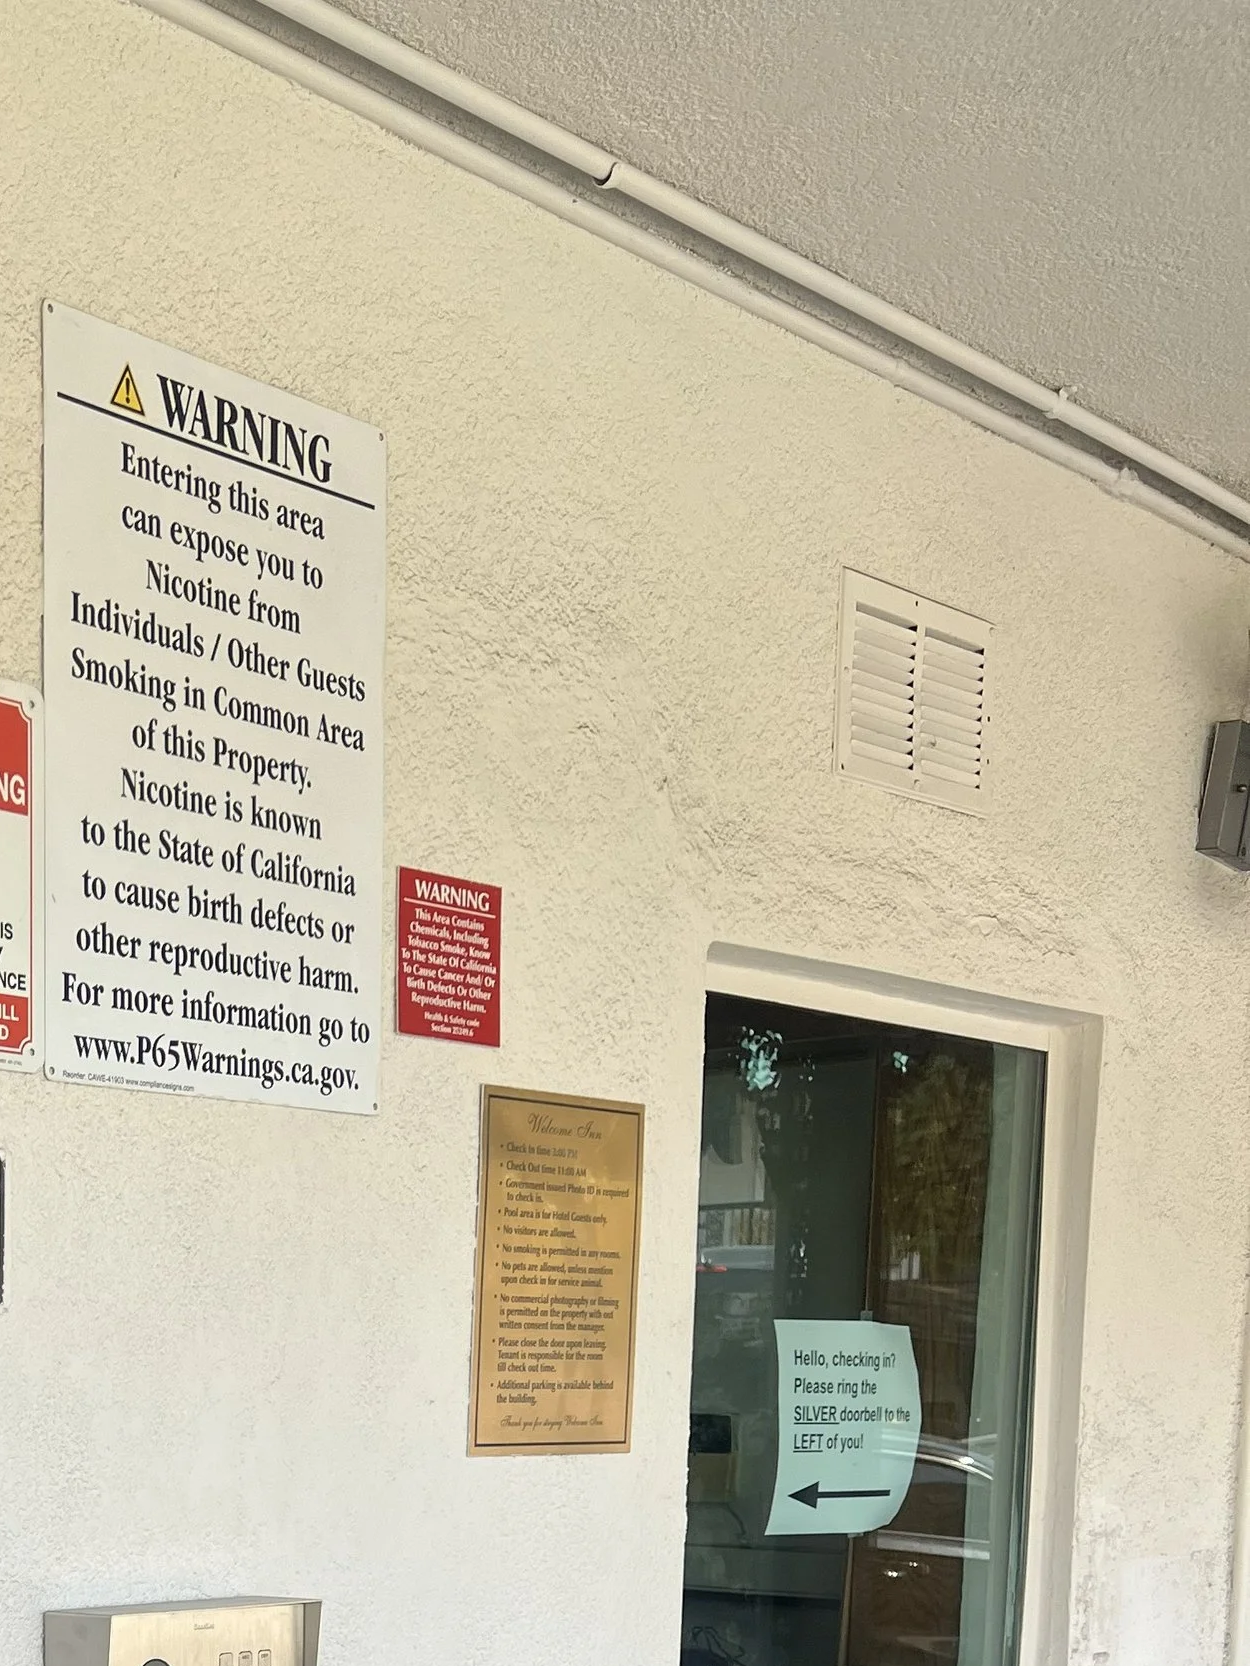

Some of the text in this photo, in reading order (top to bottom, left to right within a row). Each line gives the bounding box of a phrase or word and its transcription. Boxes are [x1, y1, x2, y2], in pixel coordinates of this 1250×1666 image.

[157, 374, 332, 483] WARNING
[121, 442, 325, 540] Entering this area
[122, 505, 323, 589] can expose you to
[146, 559, 300, 634] Nicotine from
[71, 591, 365, 702] Individuals / Other Guests
[72, 647, 365, 751] Smoking in Common Area
[132, 719, 312, 794] of this Property.
[121, 768, 321, 840] Nicotine is known
[82, 815, 356, 897] to the State of California
[82, 869, 355, 944] to cause birth defects or
[415, 879, 489, 912] WARNING
[0, 920, 13, 940] IS
[415, 908, 484, 931] This Area Contains
[408, 935, 438, 950] Tobacco
[440, 941, 468, 957] Smoke,
[410, 922, 489, 949] Chemicals, Including
[77, 922, 359, 994] other reproductive harm.
[402, 948, 496, 974] To The State Of California
[403, 962, 412, 972] To
[413, 964, 437, 978] Cause
[438, 968, 464, 982] Cancer
[485, 976, 495, 988] Or
[407, 977, 492, 1001] Birth Defects Or Other
[412, 991, 486, 1013] Reproductive Harm.
[62, 972, 370, 1047] For more information go to
[424, 1012, 443, 1022] Health
[74, 1033, 359, 1096] www.P65Warnings.ca.gov.
[528, 1112, 602, 1139] Welcome Inn
[507, 1162, 526, 1172] Check
[528, 1162, 540, 1173] Out
[542, 1164, 555, 1175] time
[575, 1168, 586, 1177] AM
[504, 1207, 518, 1217] Pool
[520, 1210, 533, 1218] area
[535, 1210, 540, 1219] is
[542, 1211, 551, 1219] for
[553, 1211, 569, 1220] Hotel
[571, 1212, 591, 1222] Guests
[503, 1225, 512, 1234] No
[514, 1225, 537, 1236] visitors
[538, 1229, 548, 1237] are
[502, 1261, 511, 1270] No
[512, 1262, 525, 1272] pets
[794, 1350, 896, 1371] Hello, checking in?
[497, 1381, 530, 1389] Additional
[532, 1381, 556, 1392] parking
[564, 1381, 591, 1389] available
[593, 1381, 613, 1389] behind
[794, 1378, 877, 1398] Please ring the
[794, 1406, 910, 1422] SILVER doorbell to the
[794, 1434, 863, 1453] LEFT of you!
